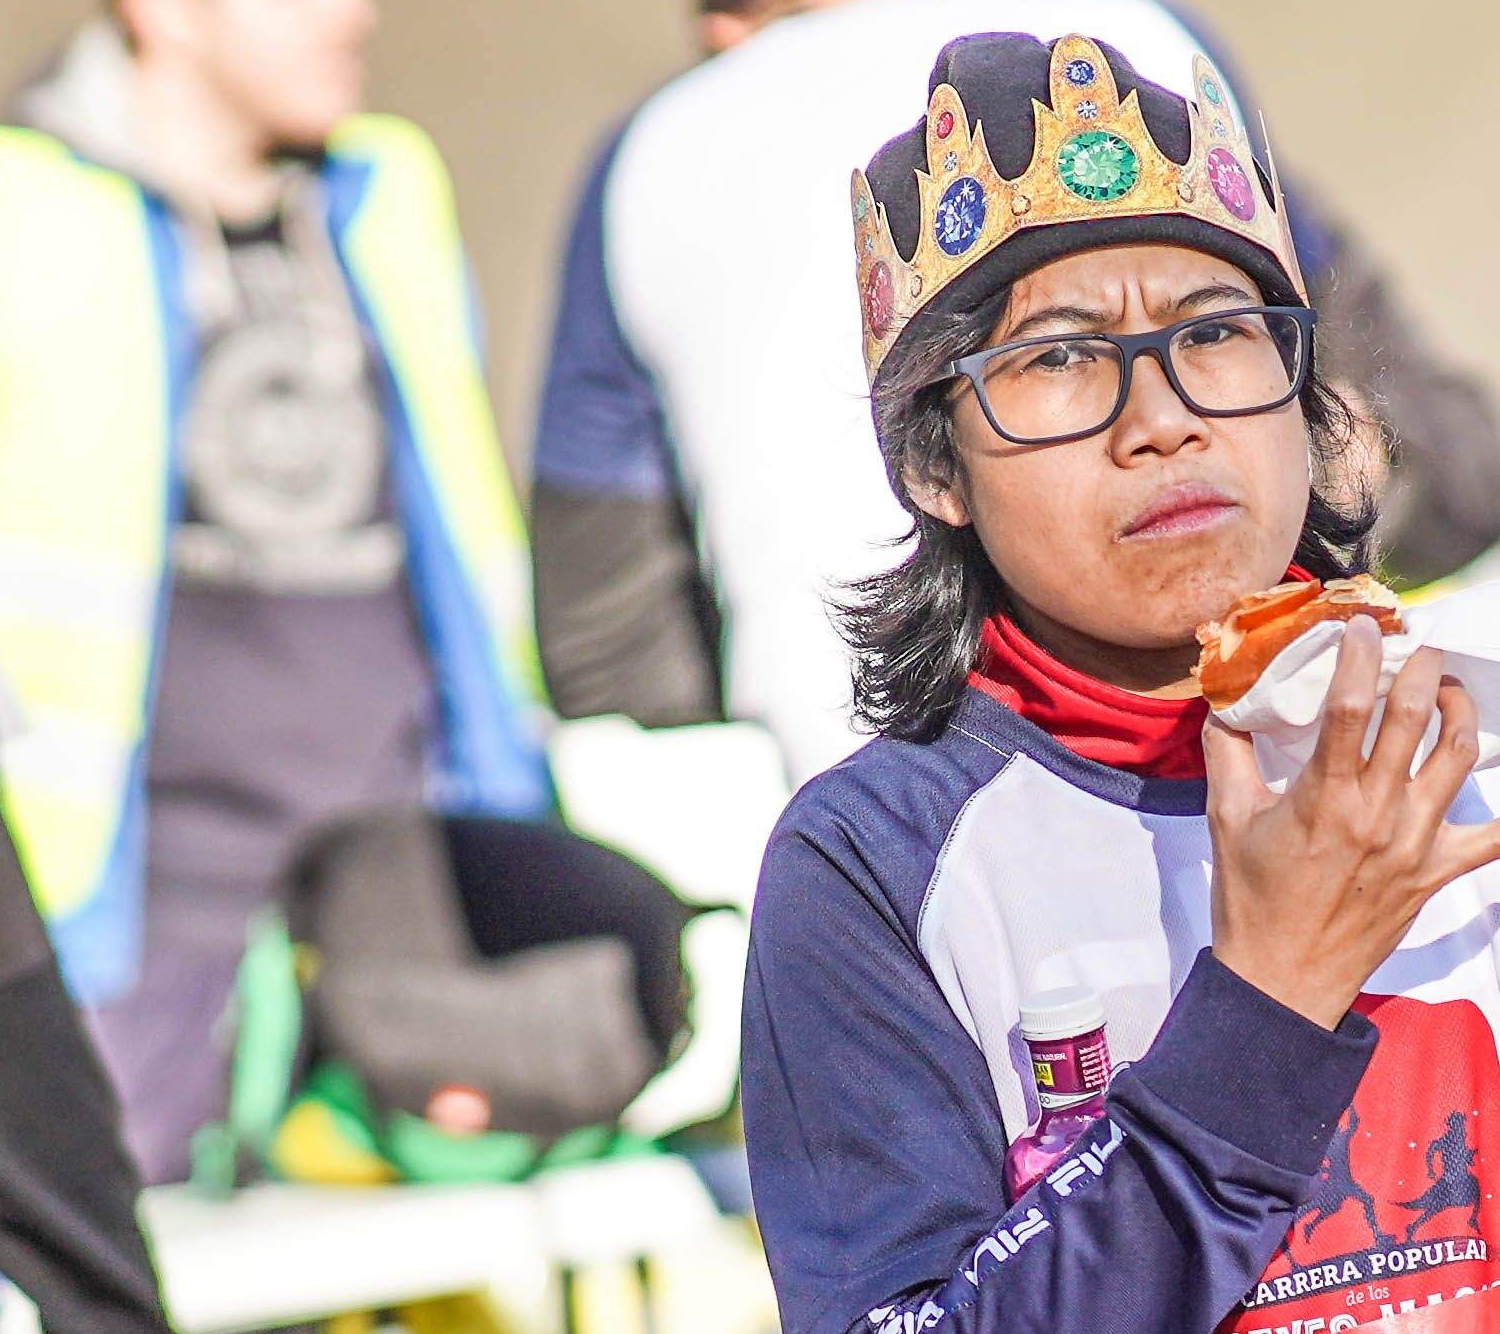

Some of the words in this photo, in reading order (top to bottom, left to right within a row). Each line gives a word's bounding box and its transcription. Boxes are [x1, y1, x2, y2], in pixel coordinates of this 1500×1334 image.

[964, 1207, 1050, 1286] FILA
[1346, 1290, 1365, 1306] de
[1368, 1285, 1390, 1300] los
